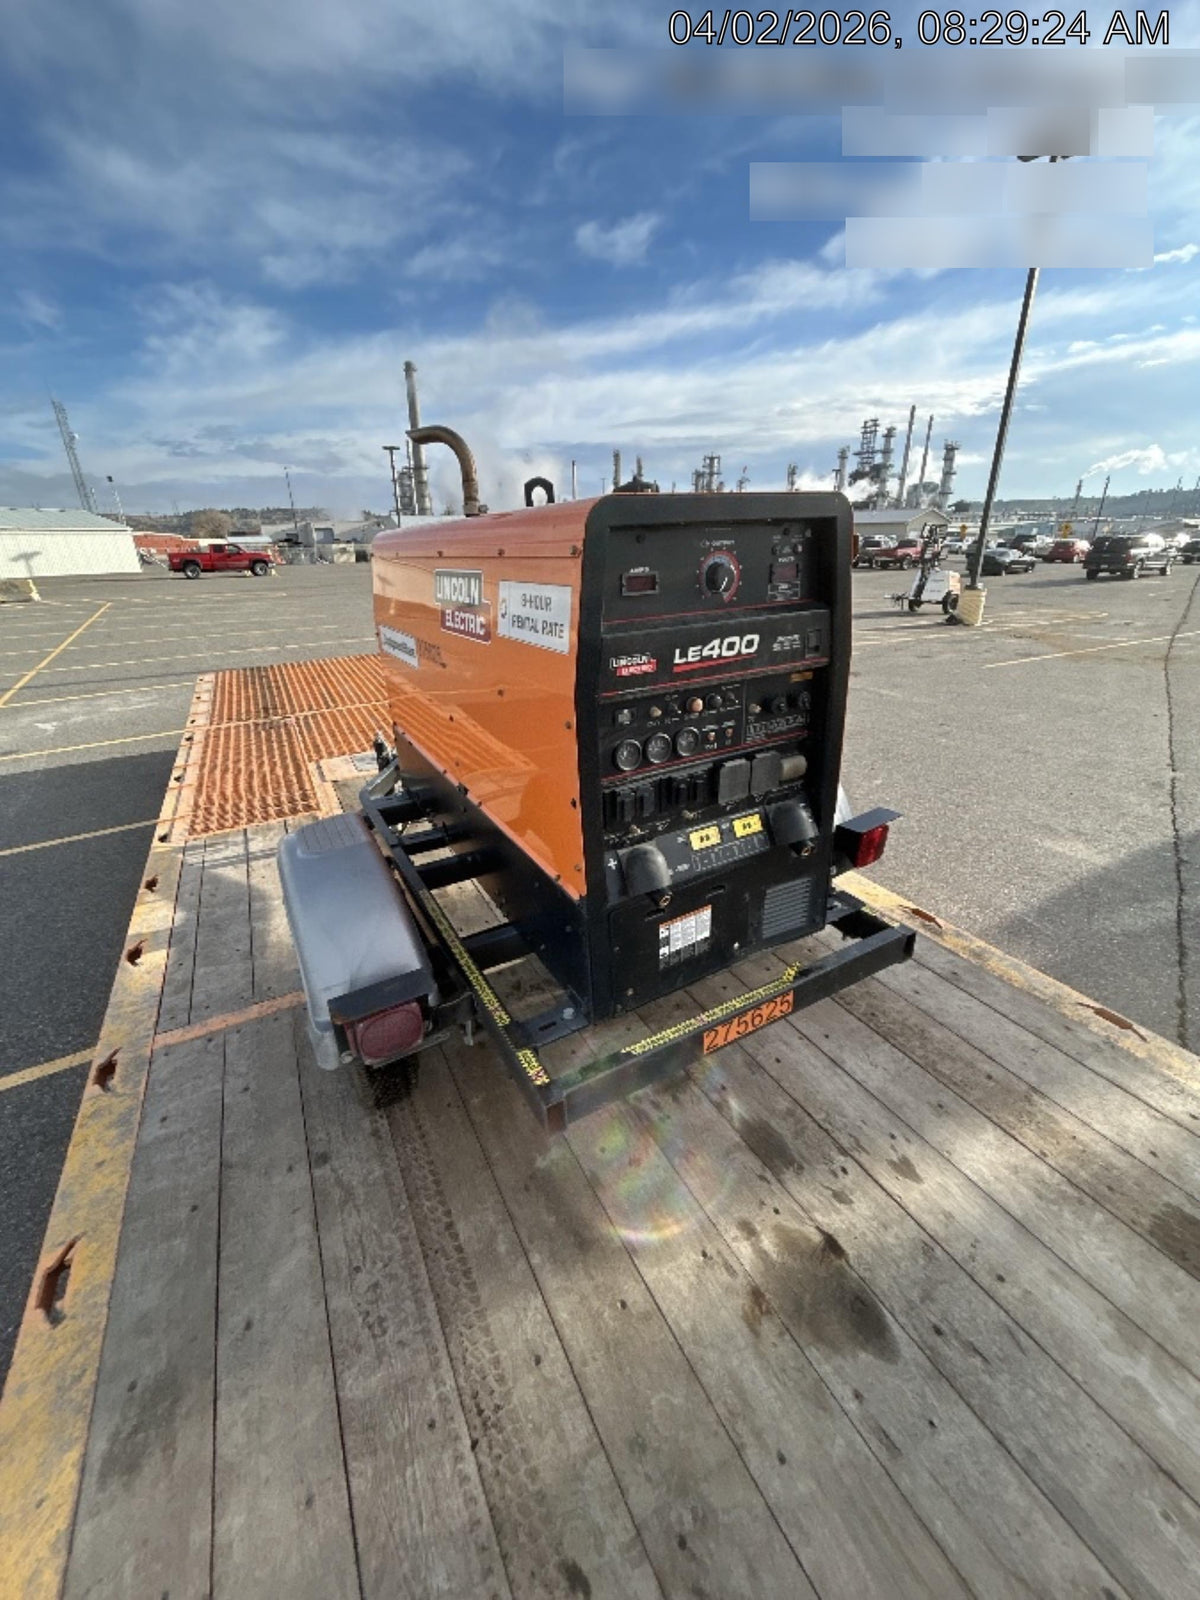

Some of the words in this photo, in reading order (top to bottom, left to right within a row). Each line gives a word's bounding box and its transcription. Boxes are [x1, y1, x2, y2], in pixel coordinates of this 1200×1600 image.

[436, 575, 479, 606] LINCOLN
[445, 608, 486, 636] ELECTRIC
[541, 620, 565, 639] RATE
[612, 655, 649, 668] LINCOLN
[673, 634, 760, 665] LE400
[705, 993, 793, 1052] 275625
